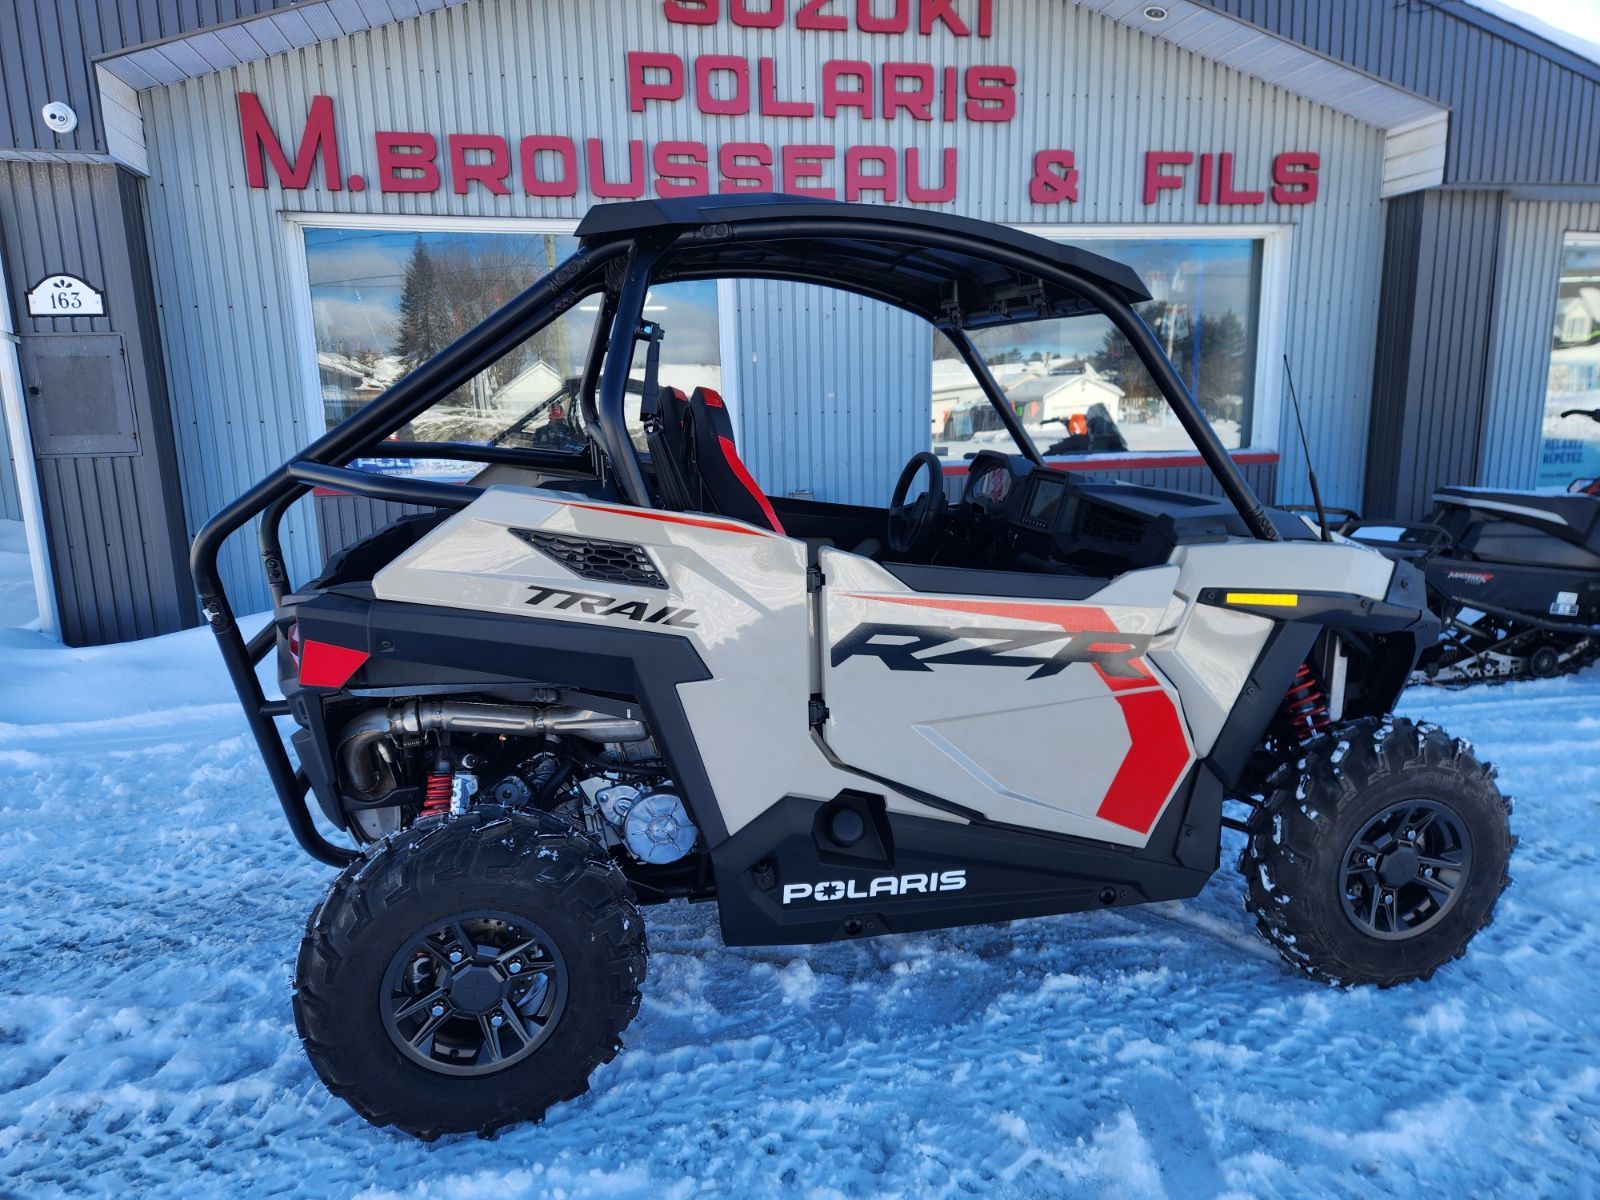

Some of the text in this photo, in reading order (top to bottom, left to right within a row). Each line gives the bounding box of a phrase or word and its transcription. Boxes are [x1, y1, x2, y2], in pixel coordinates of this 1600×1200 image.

[627, 51, 1016, 122] POLARIS
[1029, 149, 1079, 204] &
[1143, 151, 1320, 205] FILS
[50, 291, 82, 309] 163
[524, 585, 701, 629] TRAIL
[830, 621, 1155, 681] RZR
[782, 869, 967, 904] POLARIS
